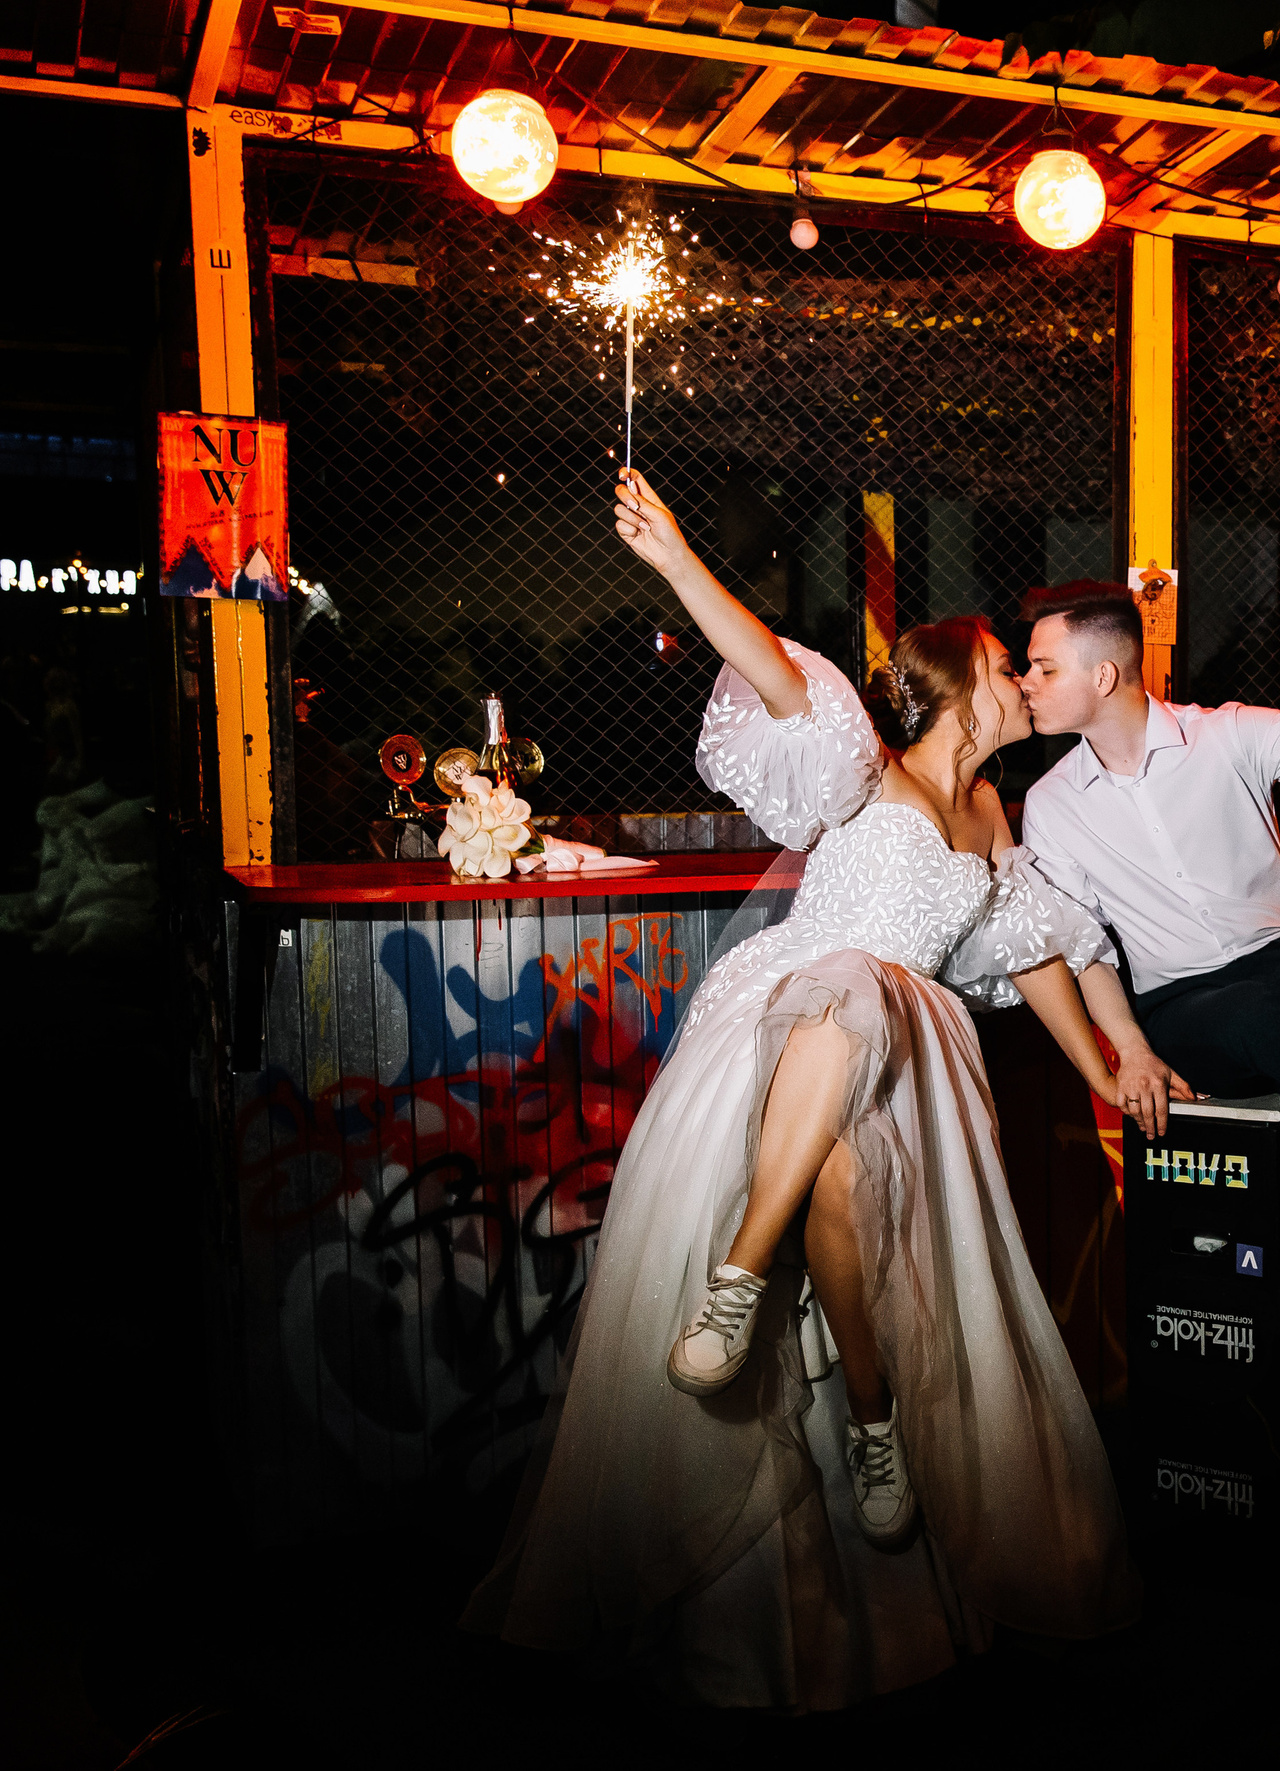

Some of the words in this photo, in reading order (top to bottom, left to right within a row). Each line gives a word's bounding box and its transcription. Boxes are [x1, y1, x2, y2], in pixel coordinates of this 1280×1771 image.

[229, 108, 275, 128] easy
[190, 424, 259, 466] NU
[199, 468, 249, 506] W
[1156, 1305, 1192, 1317] LIMONADE
[1193, 1310, 1254, 1326] KOFFEINHALTIGE
[1156, 1315, 1256, 1363] fritz-kola
[1157, 1467, 1255, 1519] fritz-kola
